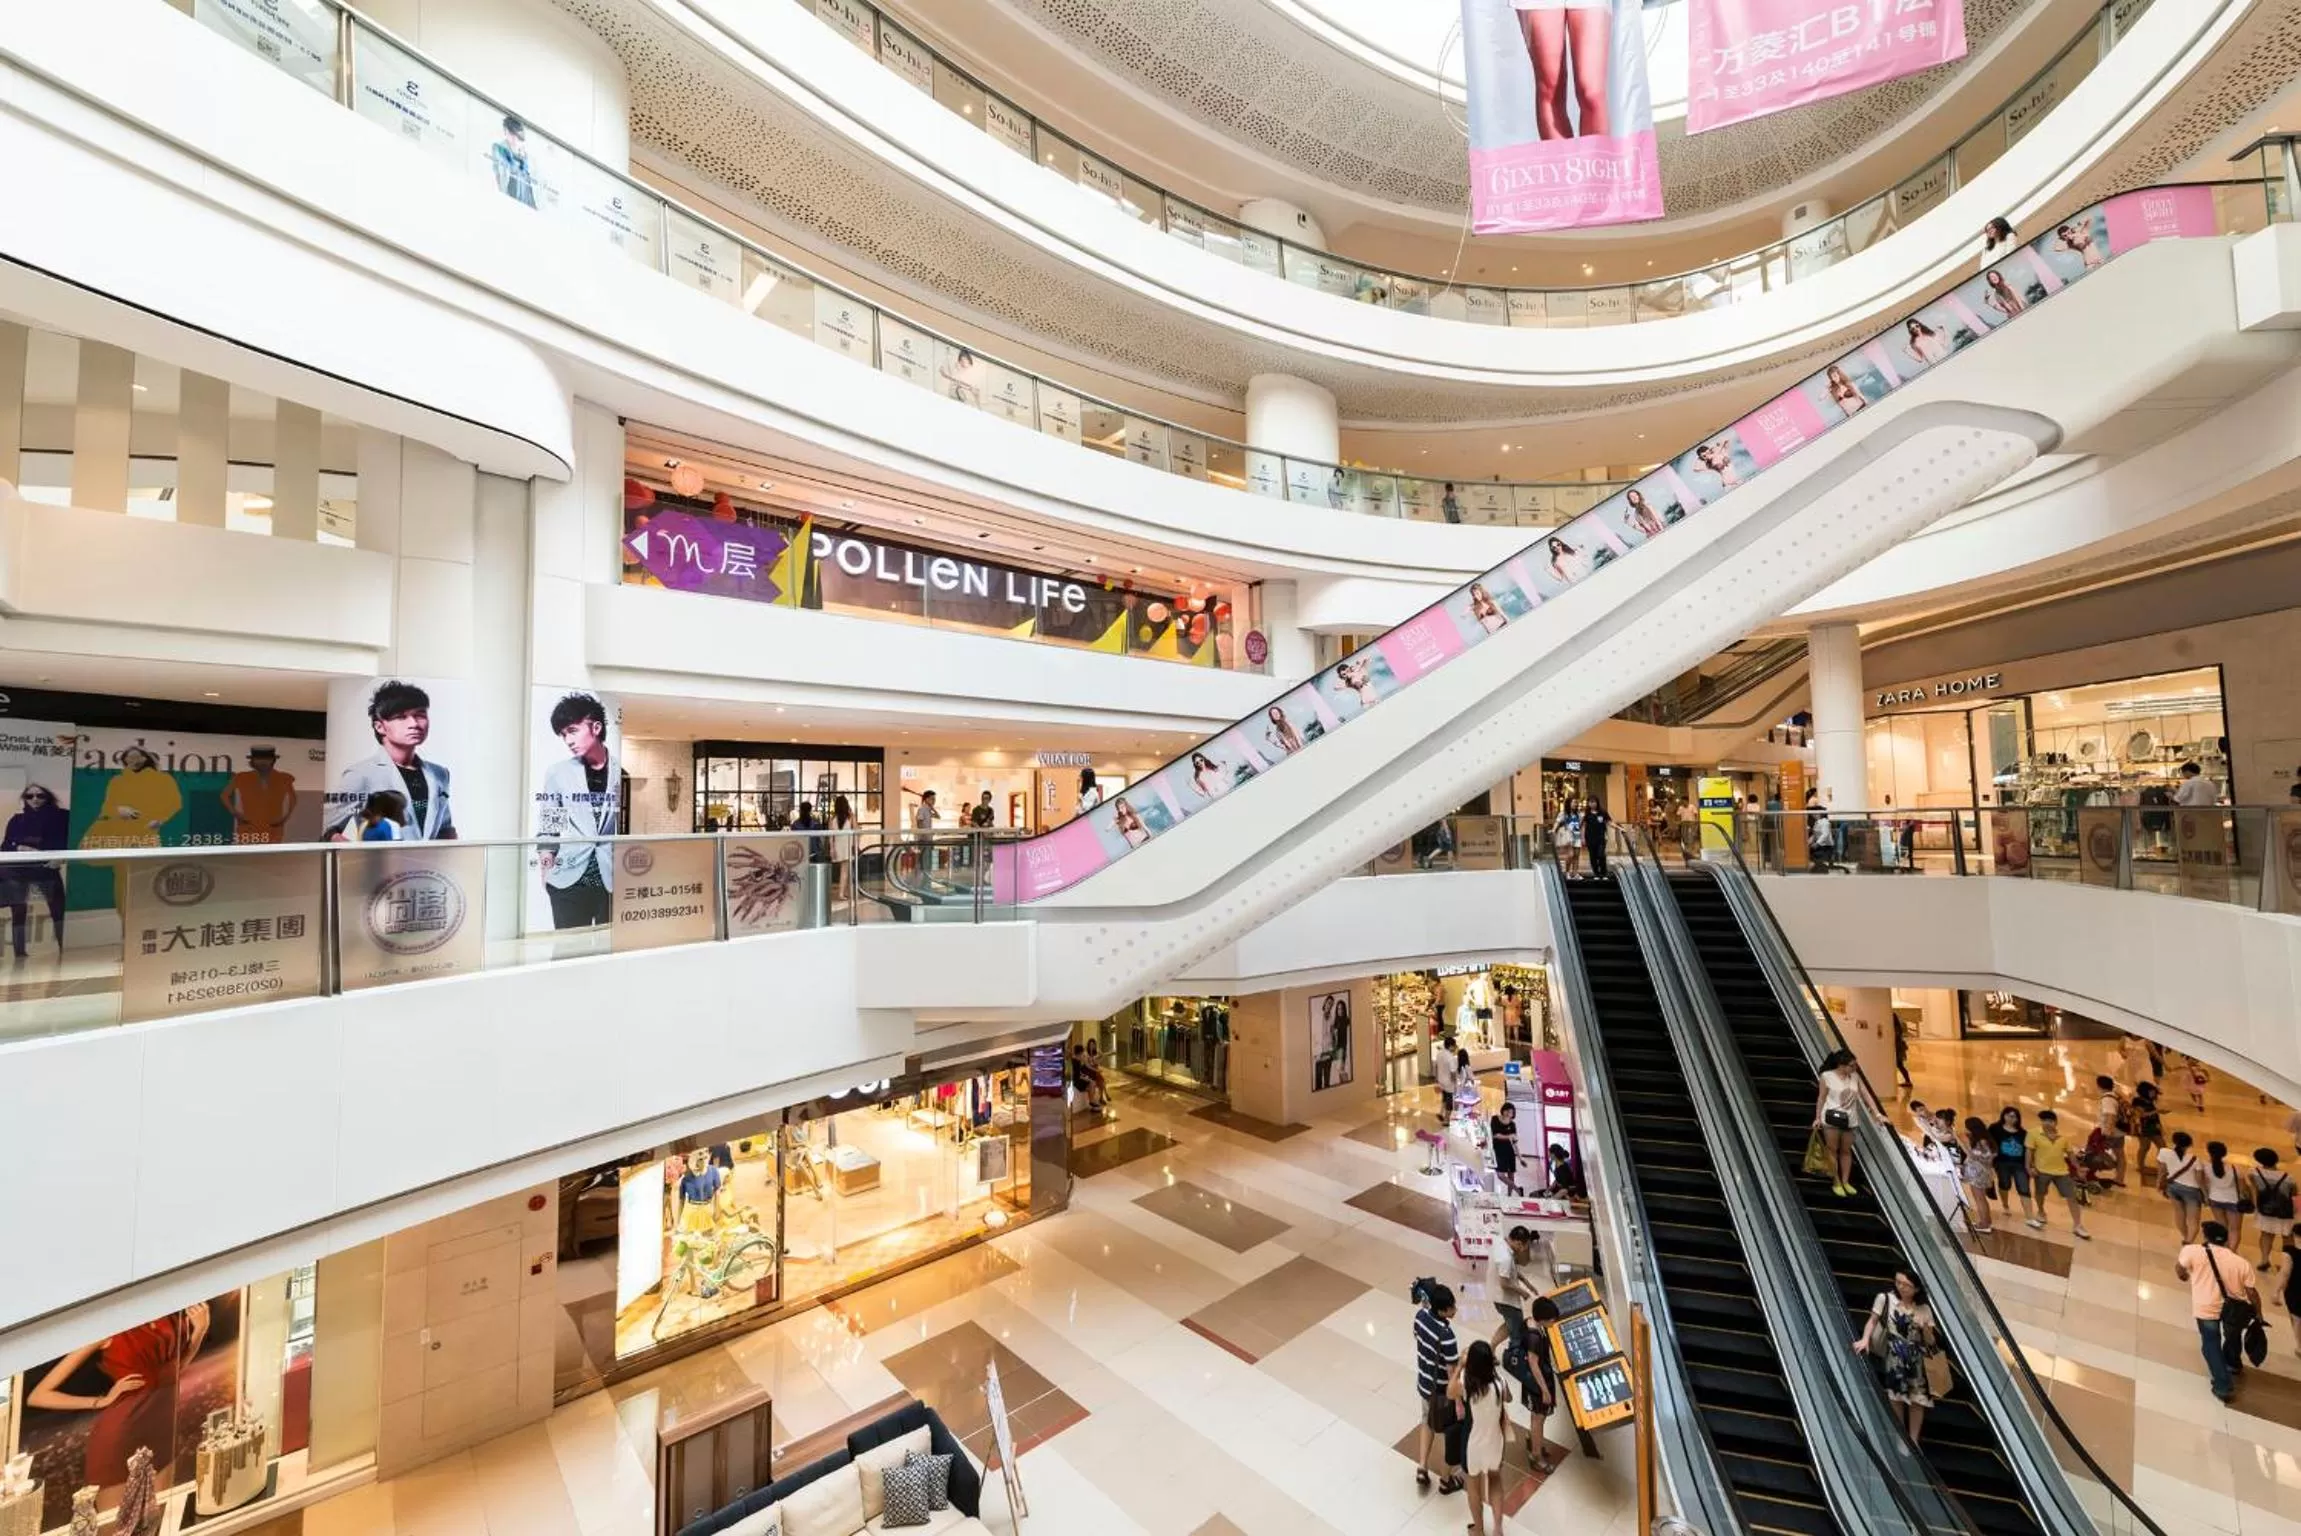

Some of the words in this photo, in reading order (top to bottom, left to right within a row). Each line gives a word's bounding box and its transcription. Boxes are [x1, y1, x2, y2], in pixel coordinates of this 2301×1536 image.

[1876, 687, 1927, 707] ZARA
[1935, 672, 2001, 696] HOME
[73, 734, 233, 781] faion
[181, 832, 270, 847] 2838-3888
[620, 904, 705, 923] (020)38992341
